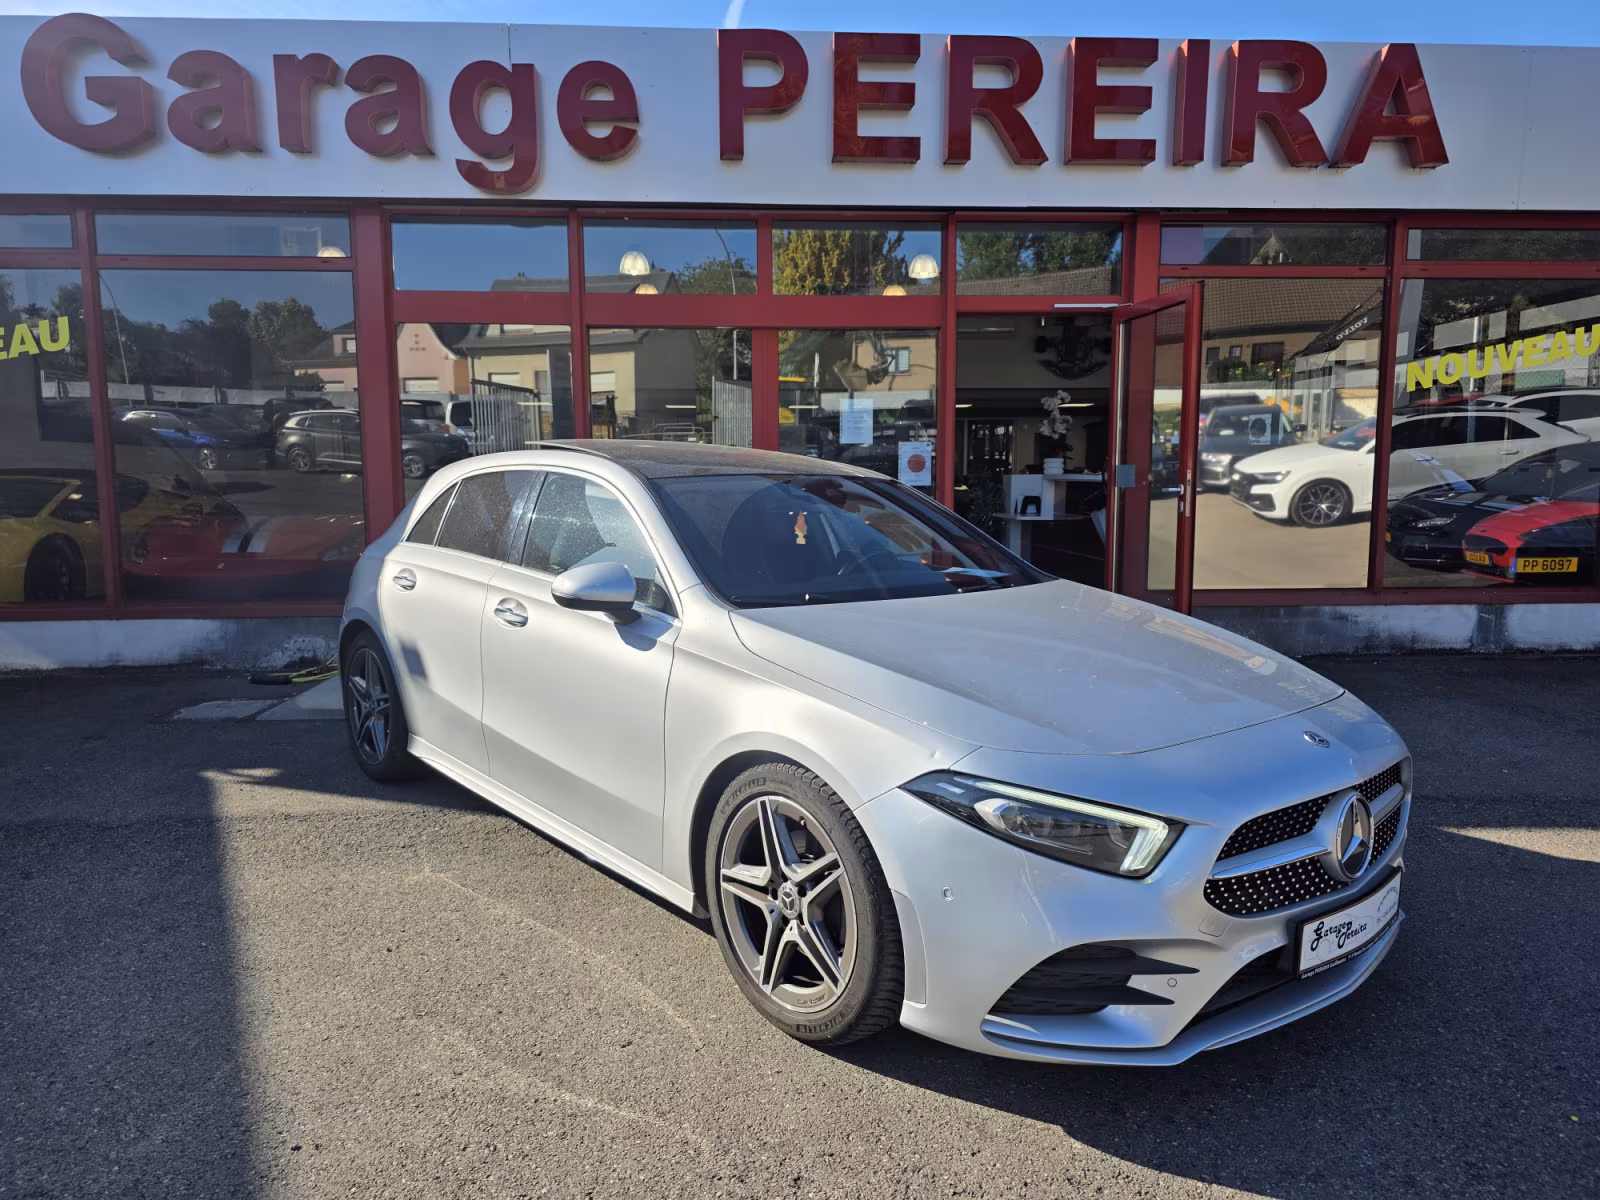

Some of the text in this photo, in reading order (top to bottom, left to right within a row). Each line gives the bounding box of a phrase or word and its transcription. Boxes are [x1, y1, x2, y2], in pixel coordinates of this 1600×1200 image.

[20, 13, 1449, 195] Garage PEREIRA
[1406, 323, 1600, 393] NOUVEAU
[1522, 559, 1573, 571] PP 6097
[1310, 920, 1348, 951] Garage
[795, 1014, 843, 1034] MICHELIN
